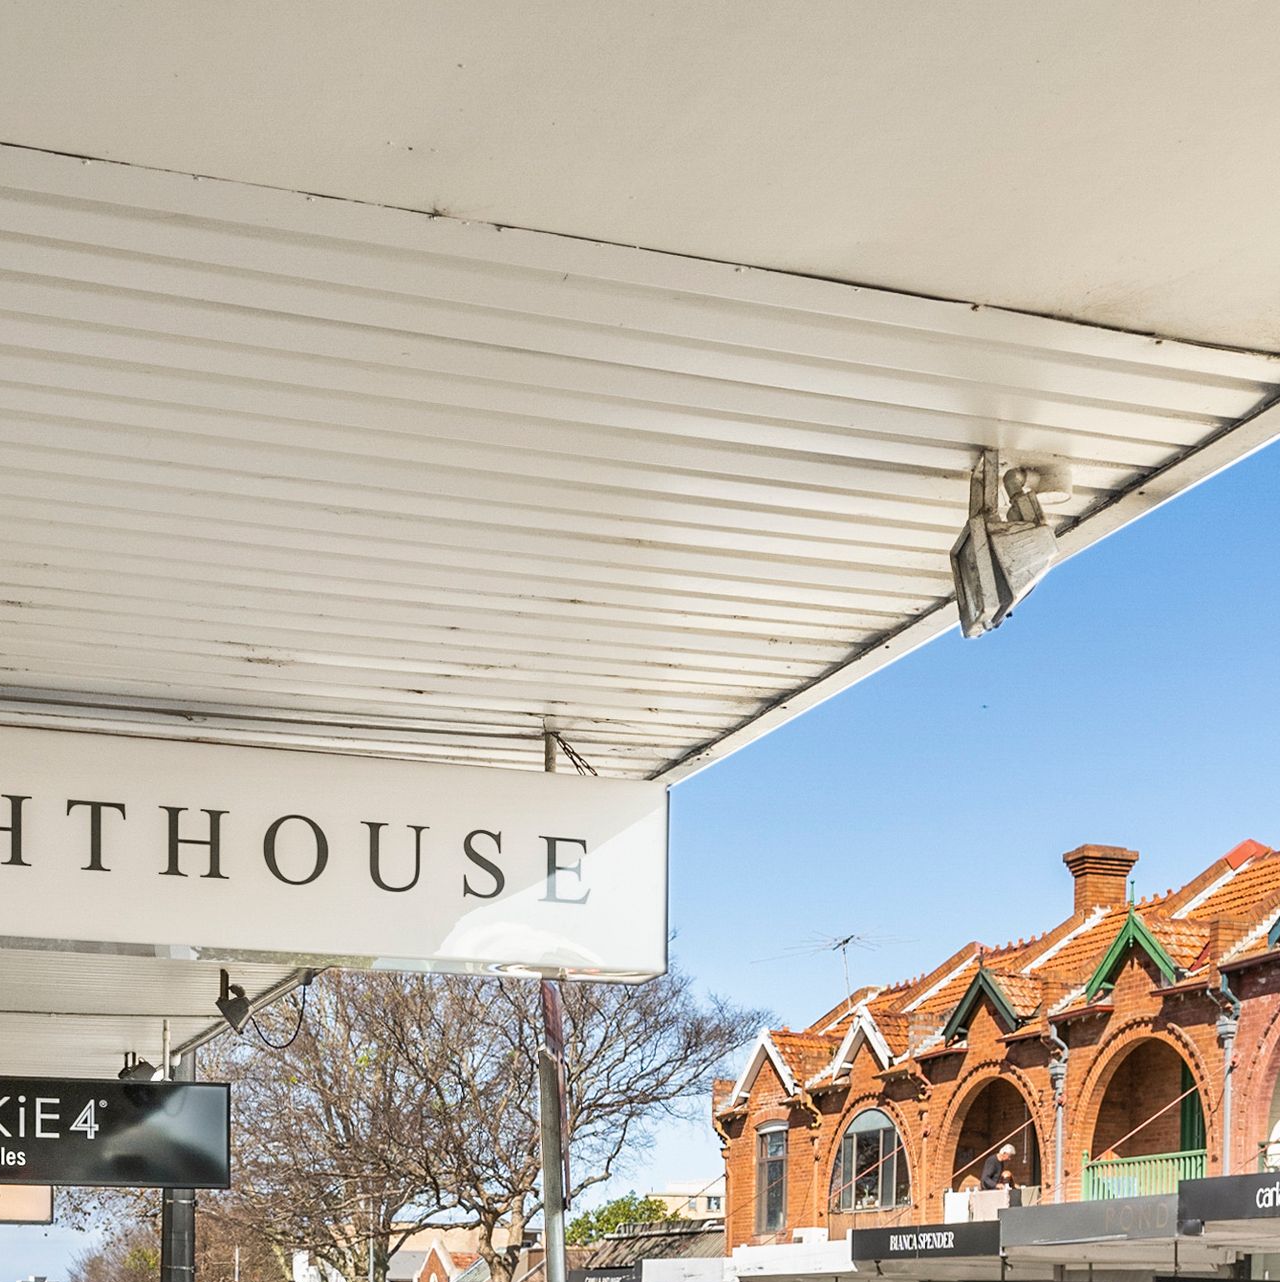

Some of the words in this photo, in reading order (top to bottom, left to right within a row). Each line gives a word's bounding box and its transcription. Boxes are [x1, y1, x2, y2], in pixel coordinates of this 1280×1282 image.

[1104, 1203, 1169, 1232] POND
[889, 1233, 917, 1250] BIANCA
[918, 1231, 954, 1249] SPENDER
